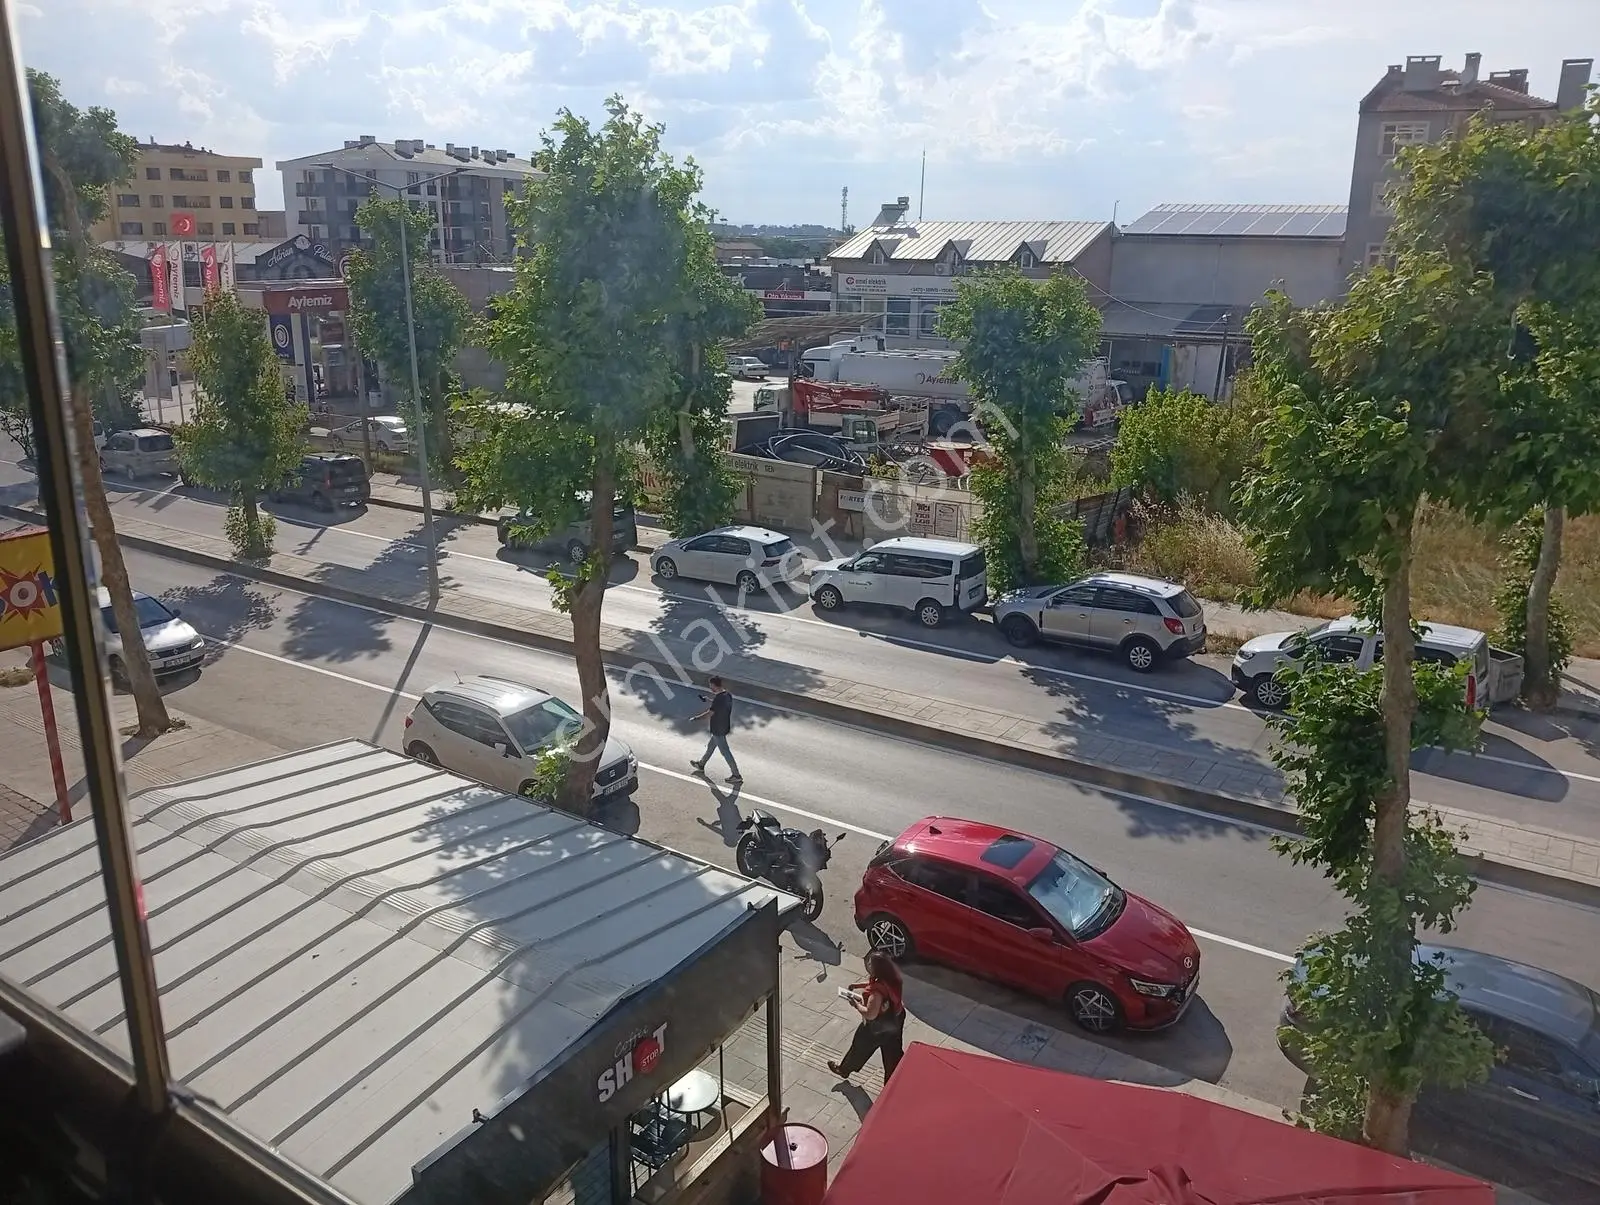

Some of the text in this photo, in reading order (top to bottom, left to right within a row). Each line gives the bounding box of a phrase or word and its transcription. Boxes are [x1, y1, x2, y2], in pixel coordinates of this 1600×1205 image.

[267, 247, 294, 267] Adrian
[171, 261, 180, 300] Aytemiz
[287, 294, 333, 309] Aytemiz
[925, 375, 958, 385] Aytemiz
[642, 1048, 660, 1067] STOP
